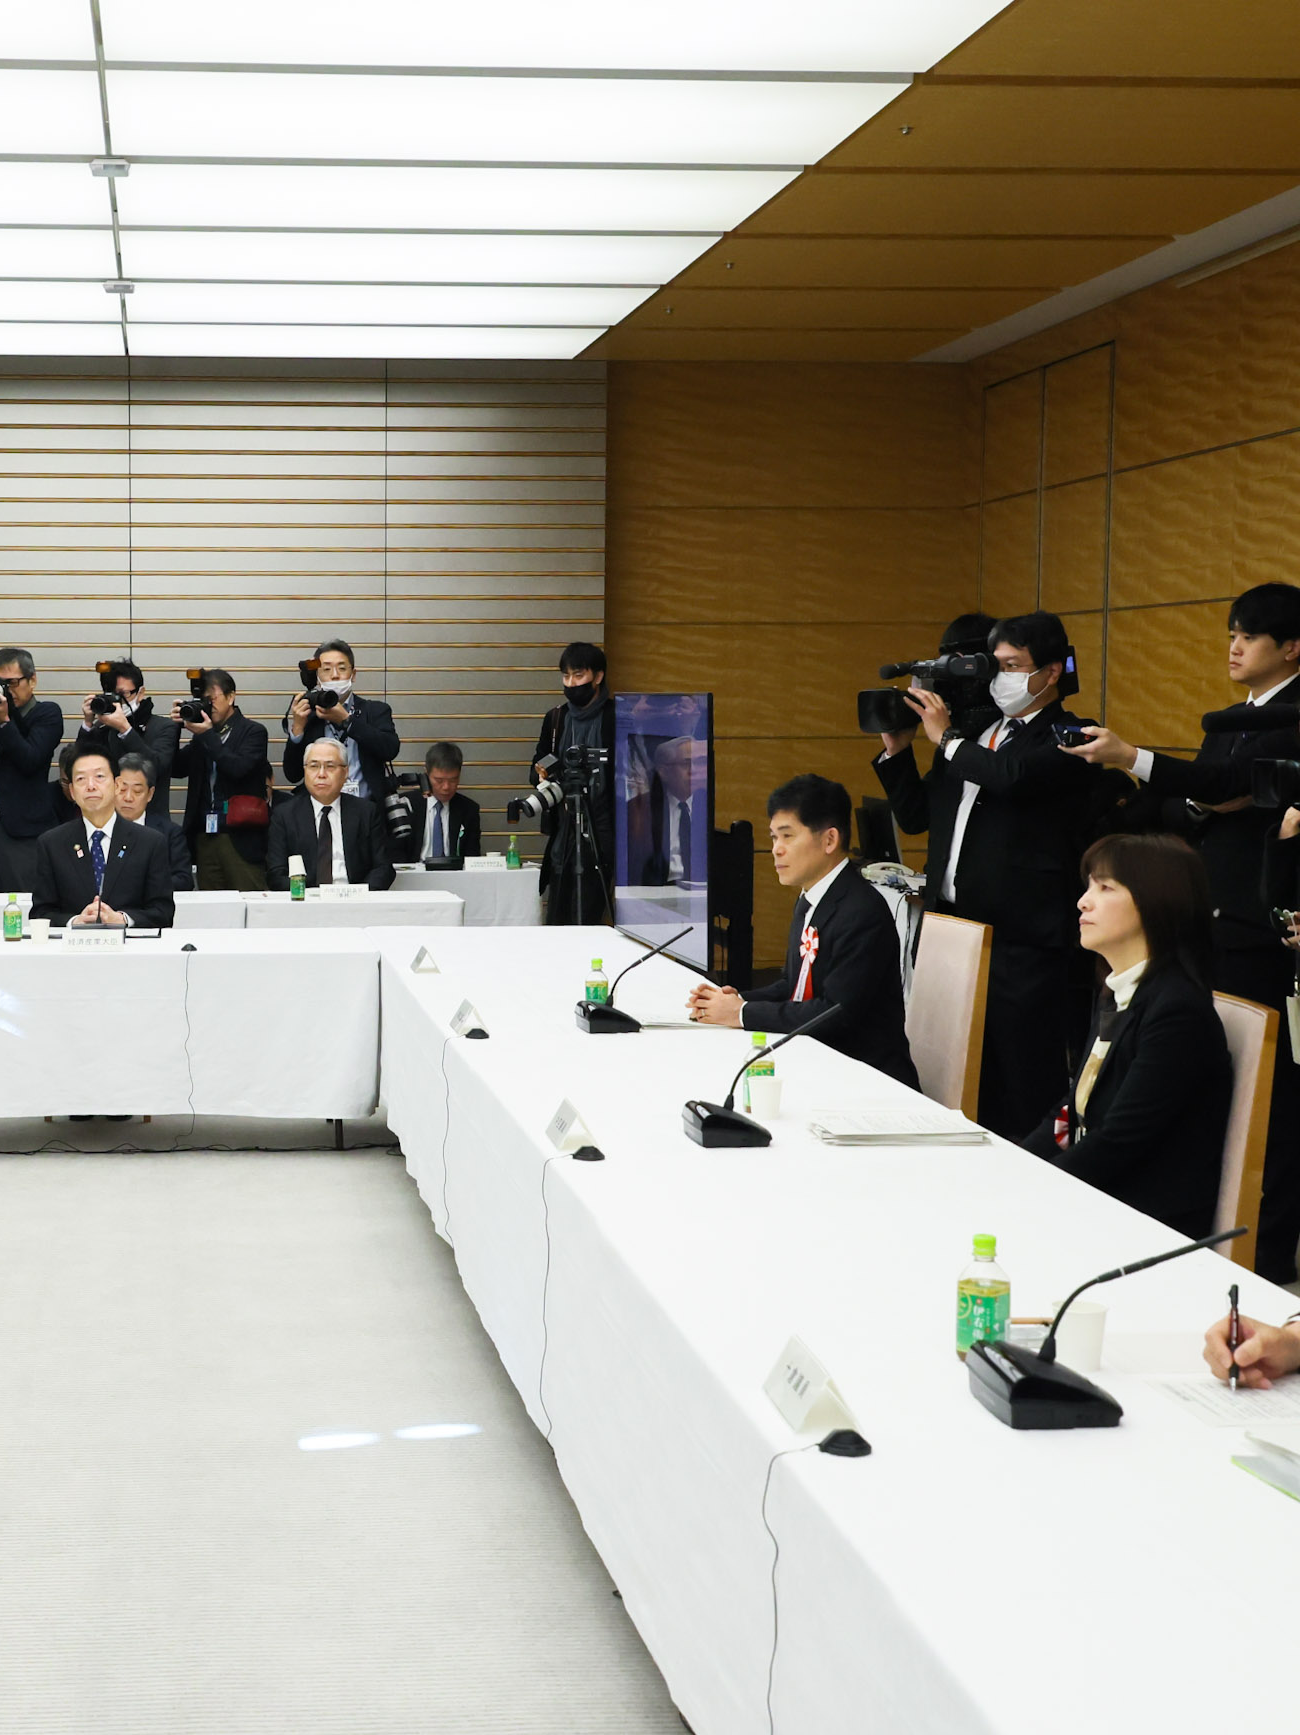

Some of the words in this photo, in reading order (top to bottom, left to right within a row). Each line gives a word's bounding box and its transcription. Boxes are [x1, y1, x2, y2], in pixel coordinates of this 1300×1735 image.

[68, 938, 118, 946] 経済産業大臣
